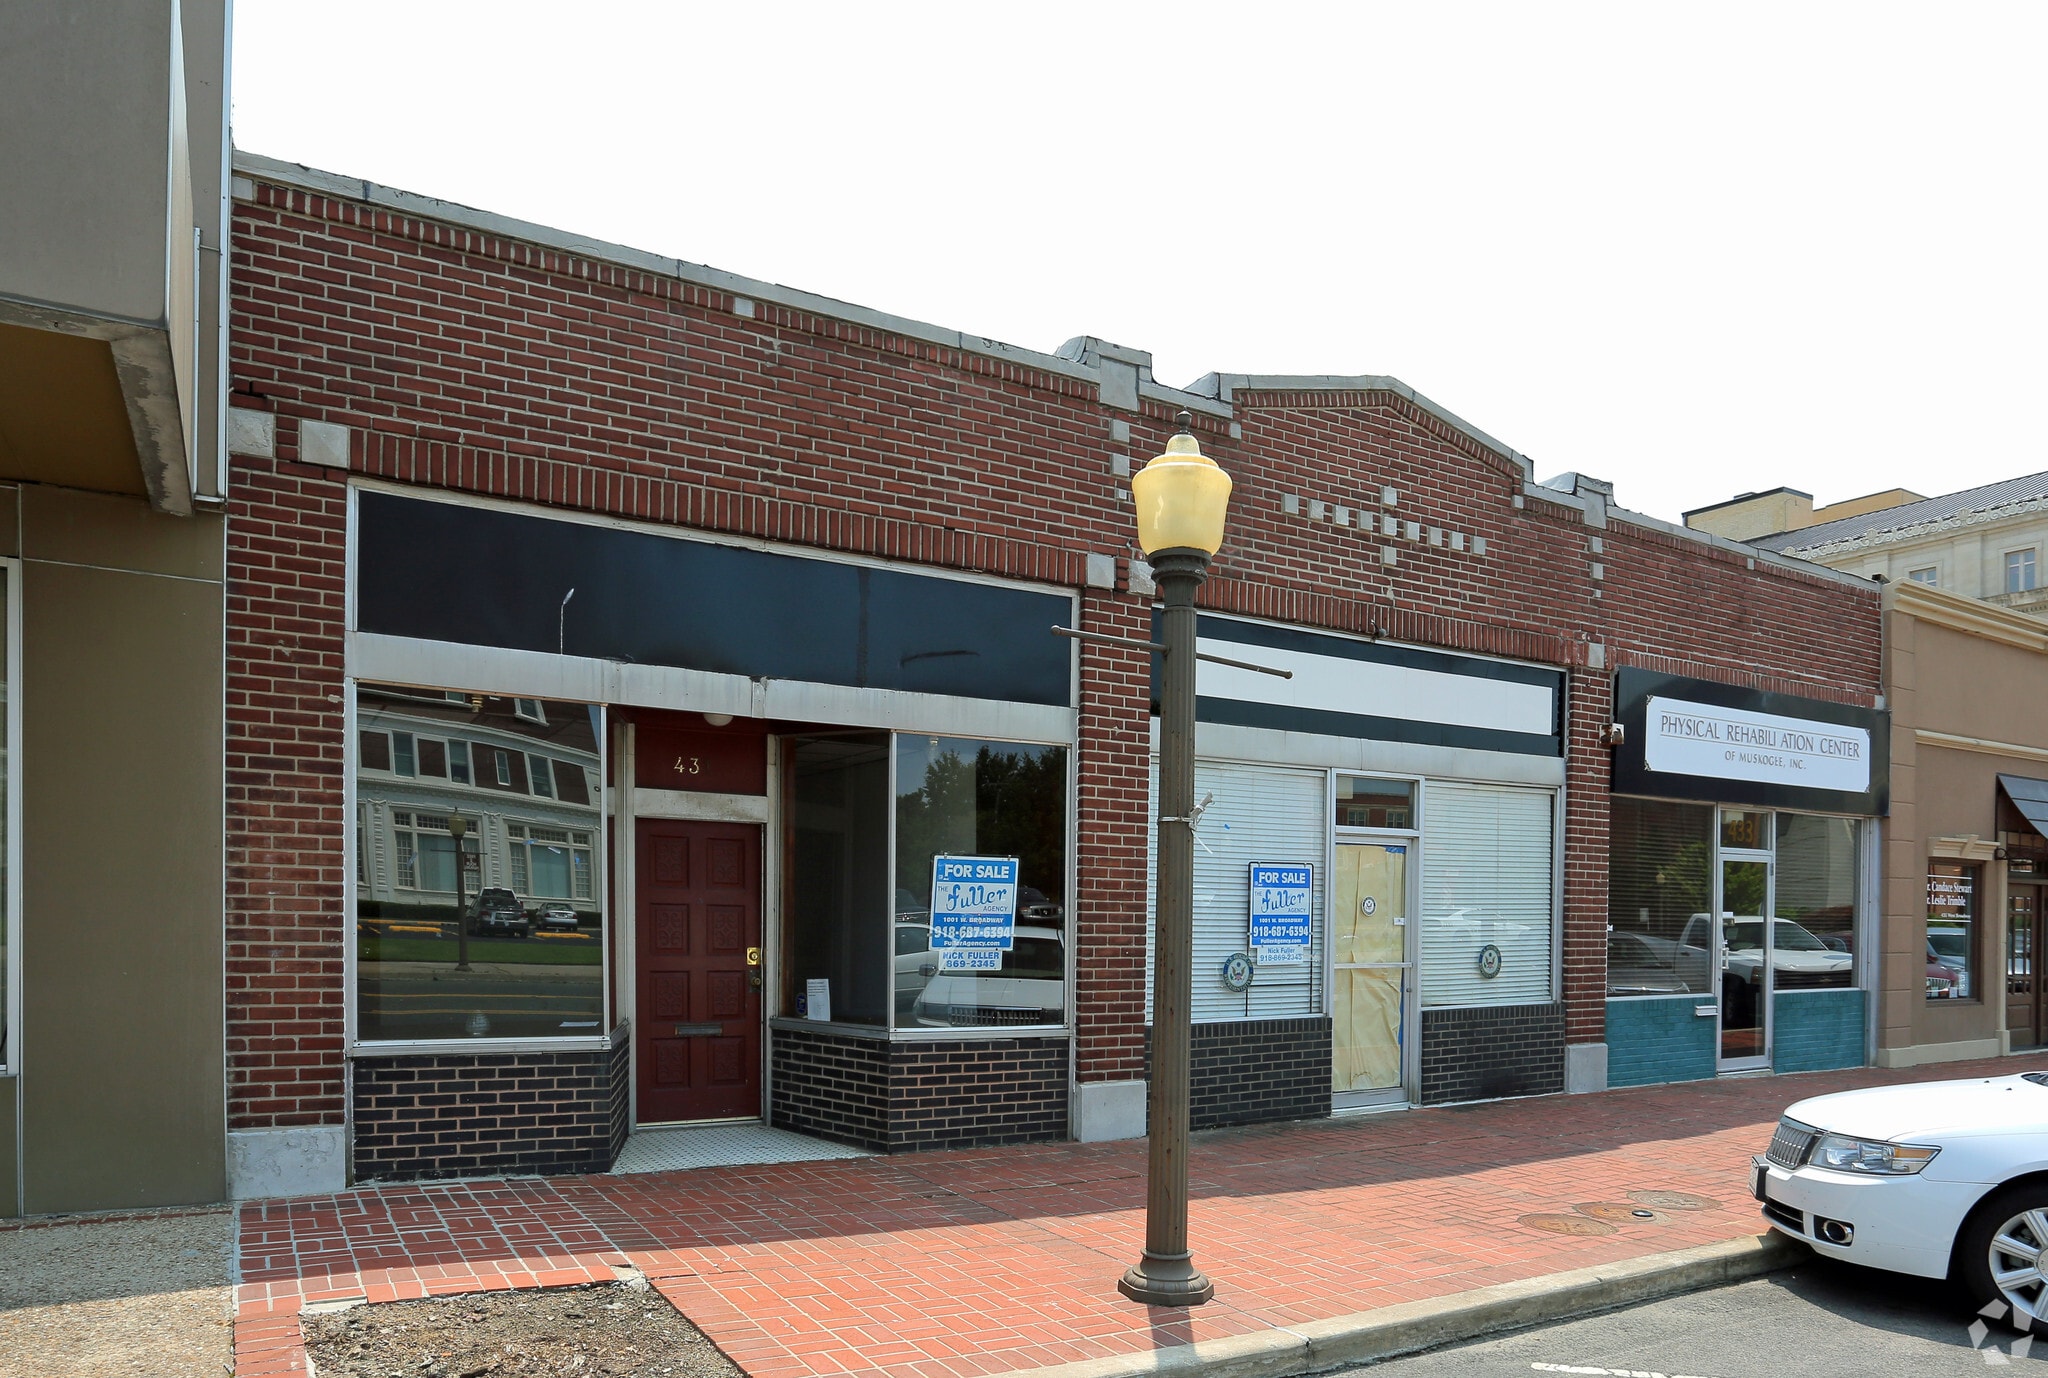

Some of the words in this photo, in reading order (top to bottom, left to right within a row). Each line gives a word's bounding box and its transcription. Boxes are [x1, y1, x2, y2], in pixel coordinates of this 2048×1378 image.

[1661, 715, 1720, 739] PHYSICAL
[1820, 737, 1860, 758] CENTER
[673, 756, 700, 775] 43
[1724, 750, 1736, 761] OF
[1739, 752, 1786, 768] MUSKOGEE,
[1789, 758, 1807, 770] INC.
[1728, 819, 1753, 842] 433
[944, 864, 972, 878] FOR
[976, 865, 1010, 879] SALE
[1258, 871, 1279, 884] FOR
[1281, 872, 1306, 884] SALE
[934, 926, 1010, 938] 918-687-6394
[1253, 926, 1309, 937] 918-687-6394
[943, 951, 964, 960] NICK
[967, 951, 1000, 960] FULLER
[946, 960, 995, 968] 869-2345
